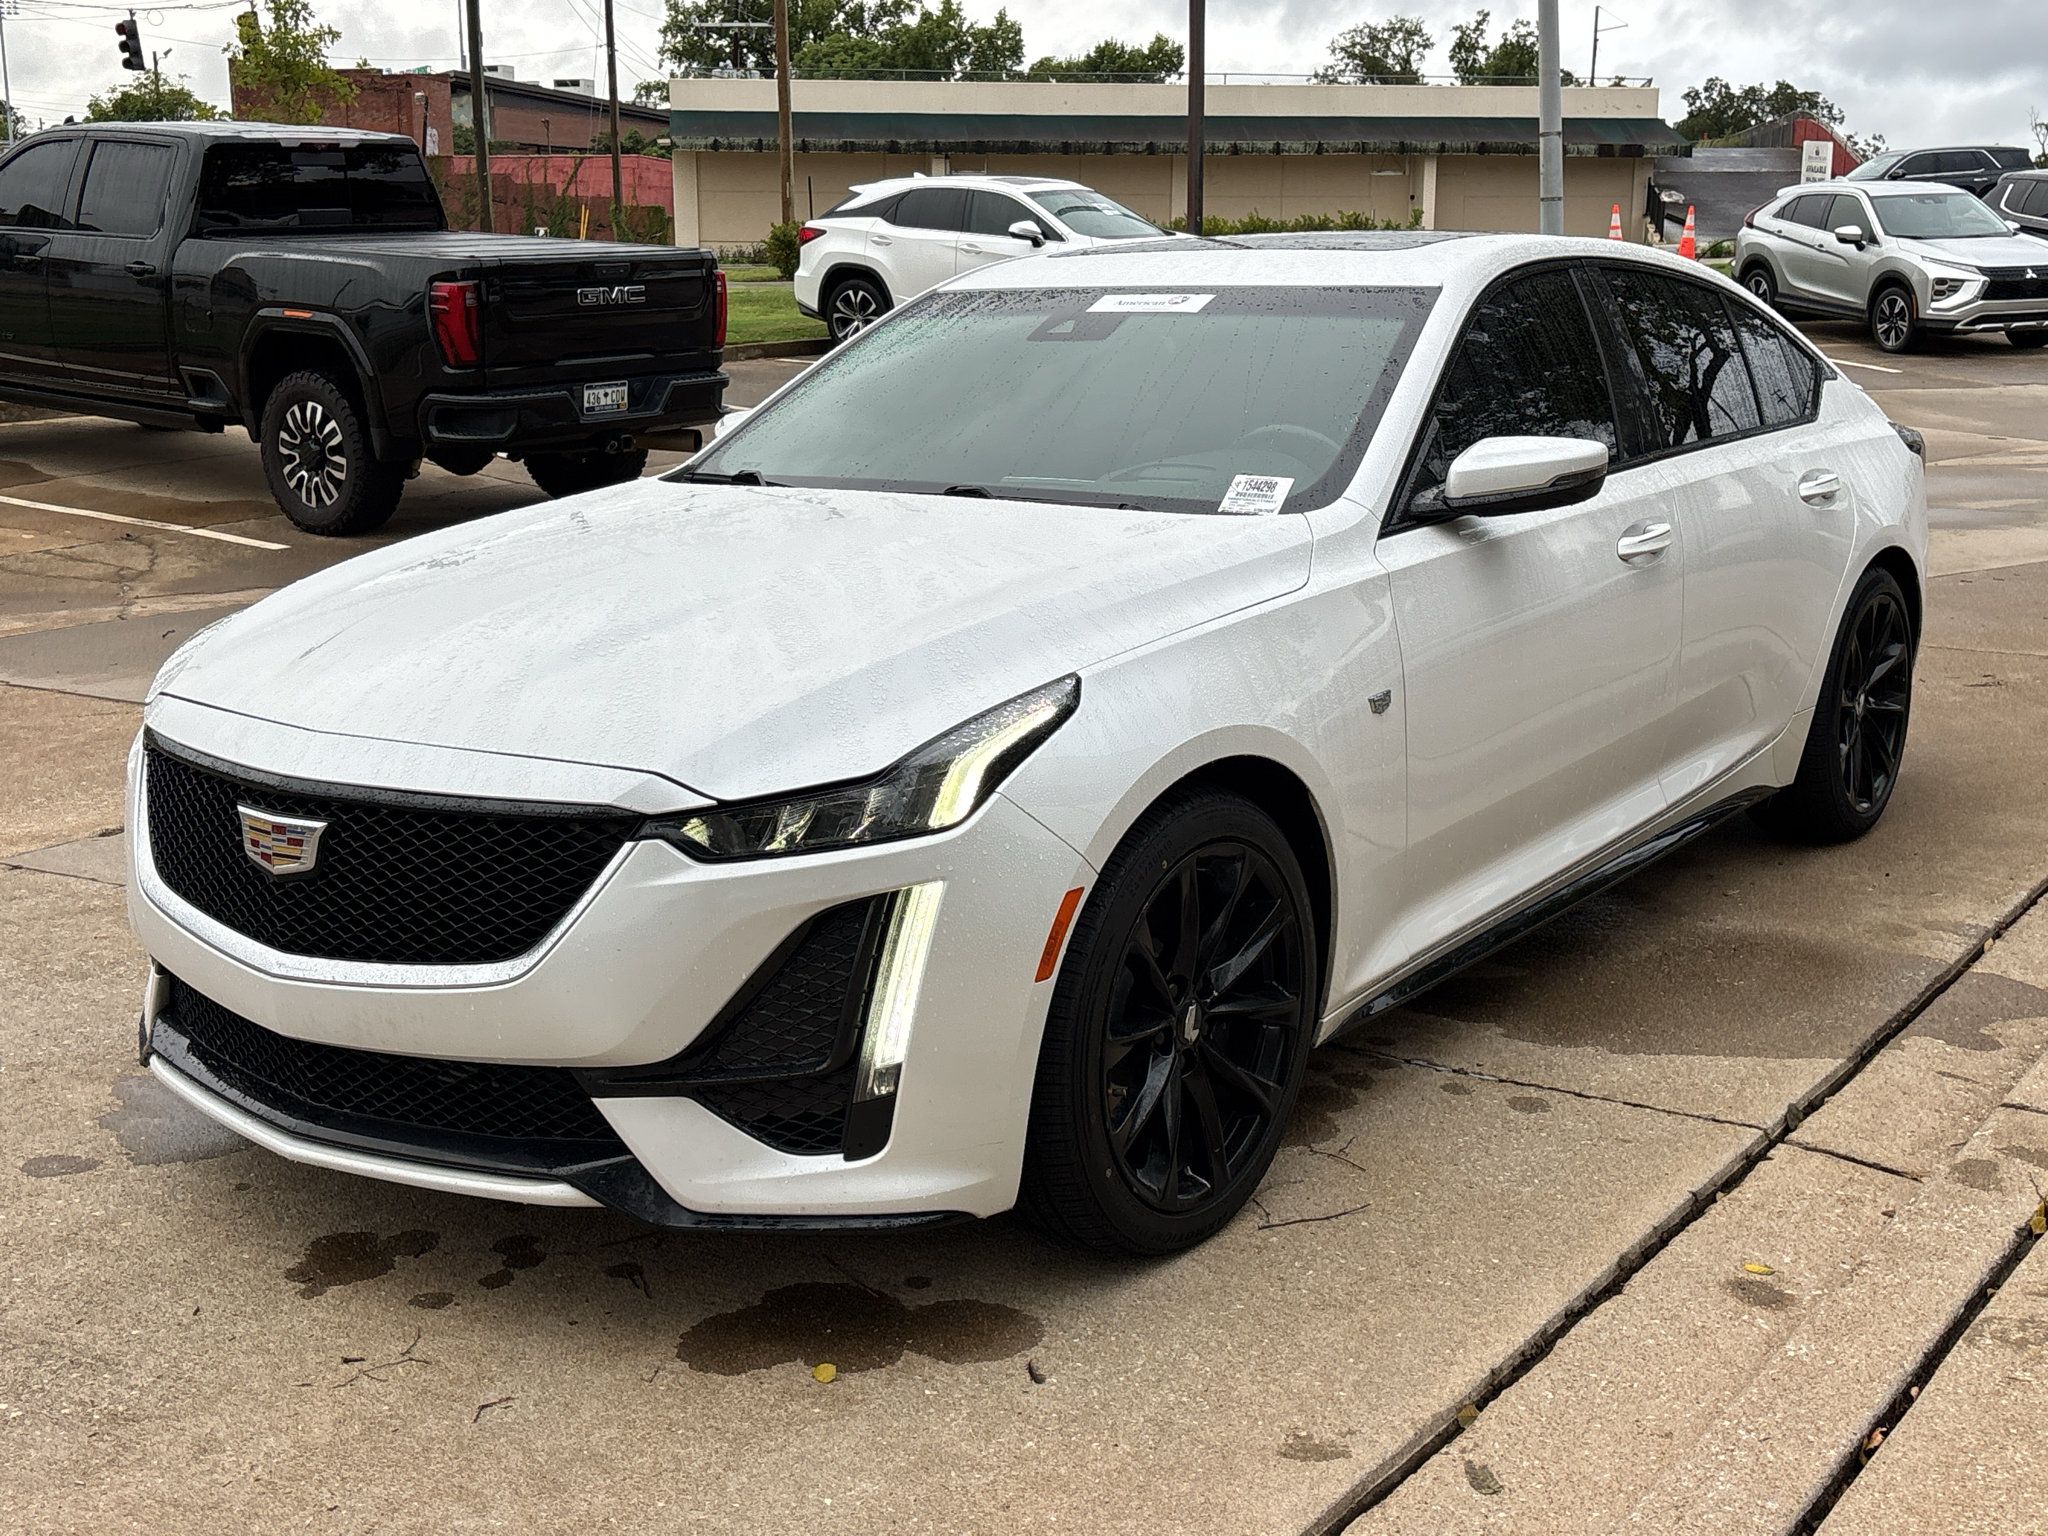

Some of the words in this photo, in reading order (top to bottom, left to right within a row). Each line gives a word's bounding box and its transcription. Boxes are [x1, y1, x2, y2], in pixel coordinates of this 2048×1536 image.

[577, 285, 646, 306] GMC
[586, 392, 601, 406] 436
[1242, 479, 1279, 493] 1544298
